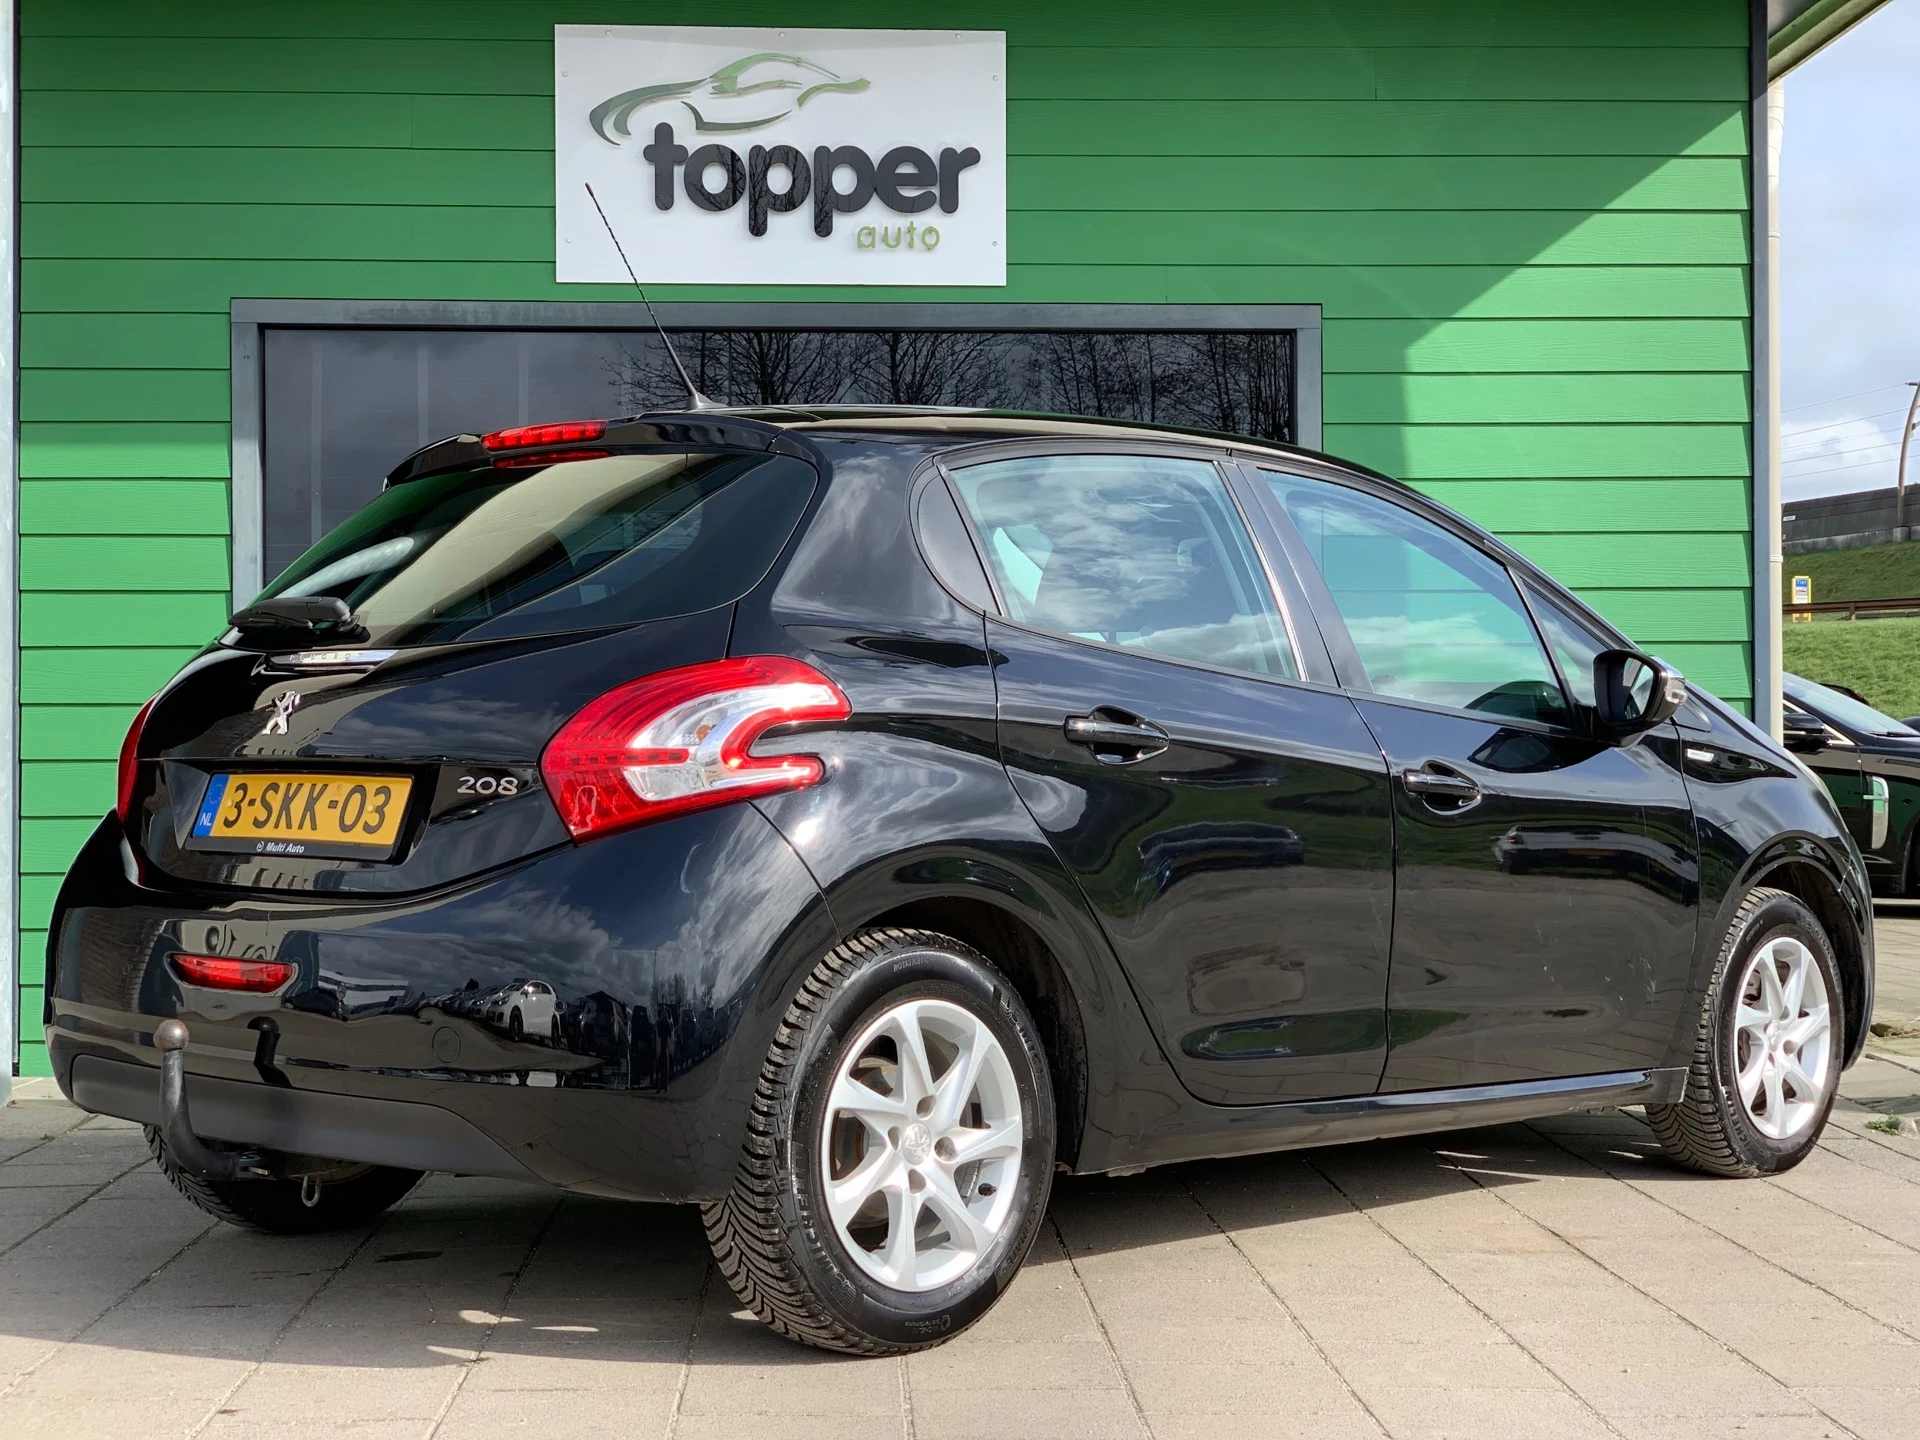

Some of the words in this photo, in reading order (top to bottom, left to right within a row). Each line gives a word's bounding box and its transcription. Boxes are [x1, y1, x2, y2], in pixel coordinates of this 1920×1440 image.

[643, 122, 981, 238] topper
[857, 221, 941, 250] auto
[289, 652, 364, 662] PEUGEOT
[457, 776, 518, 795] 208
[223, 782, 391, 834] 3-SKK-03
[200, 812, 212, 826] NL
[266, 842, 287, 852] Multi
[285, 843, 305, 853] Auto
